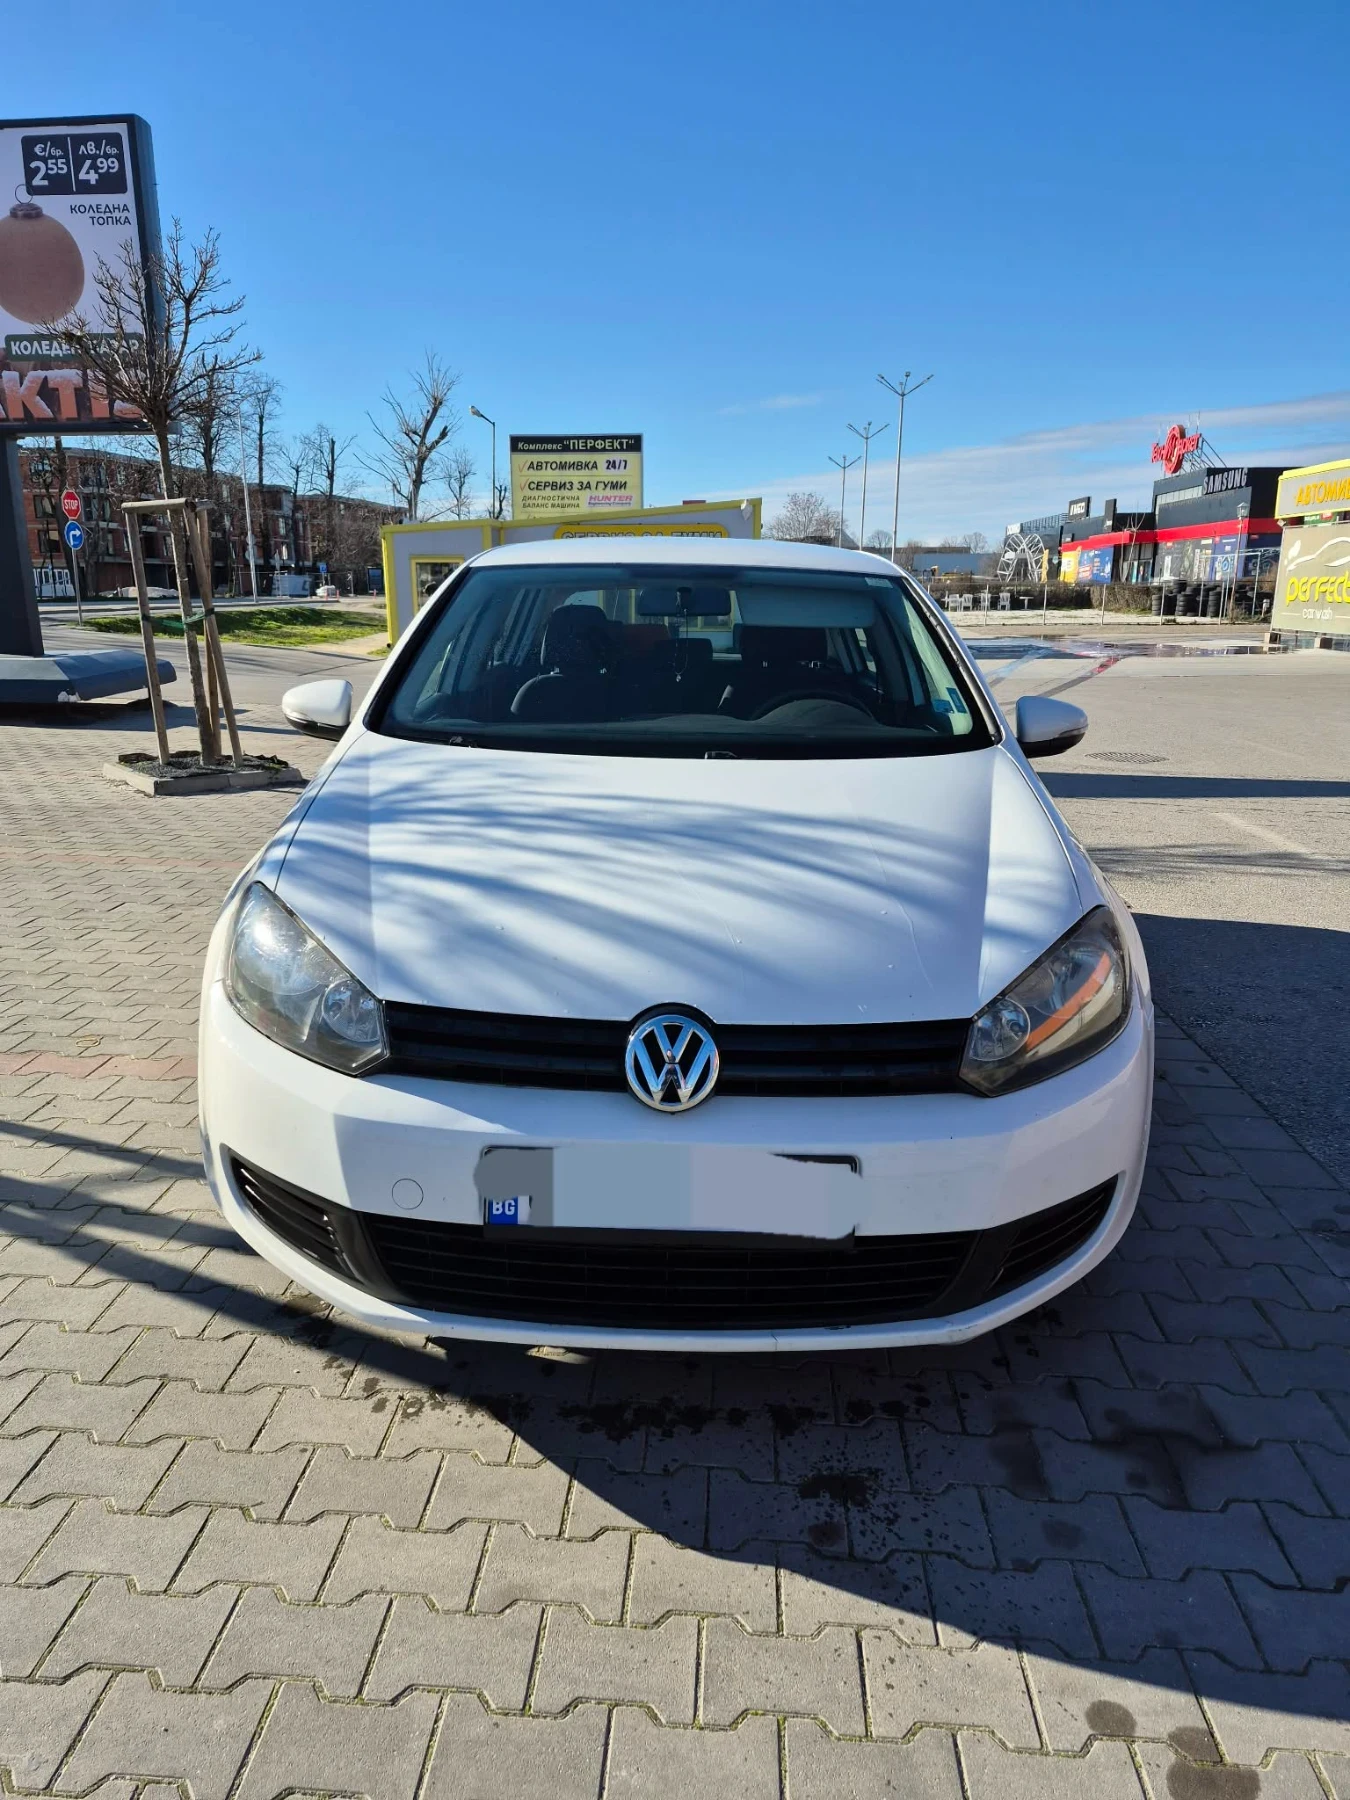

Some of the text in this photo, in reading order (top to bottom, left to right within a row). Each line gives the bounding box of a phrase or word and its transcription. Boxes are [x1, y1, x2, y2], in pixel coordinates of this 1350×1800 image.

[70, 204, 130, 214] КОЛЕДНА
[90, 216, 131, 226] ТОПКА
[518, 442, 563, 450] Комплекс
[527, 460, 627, 471] АВТОМИВКА 24/7
[528, 481, 627, 491] СЕРВИЗ ЗА ГУМИ
[1203, 467, 1248, 495] SAMSUNG
[64, 499, 79, 510] STOP
[492, 1198, 516, 1216] BG
